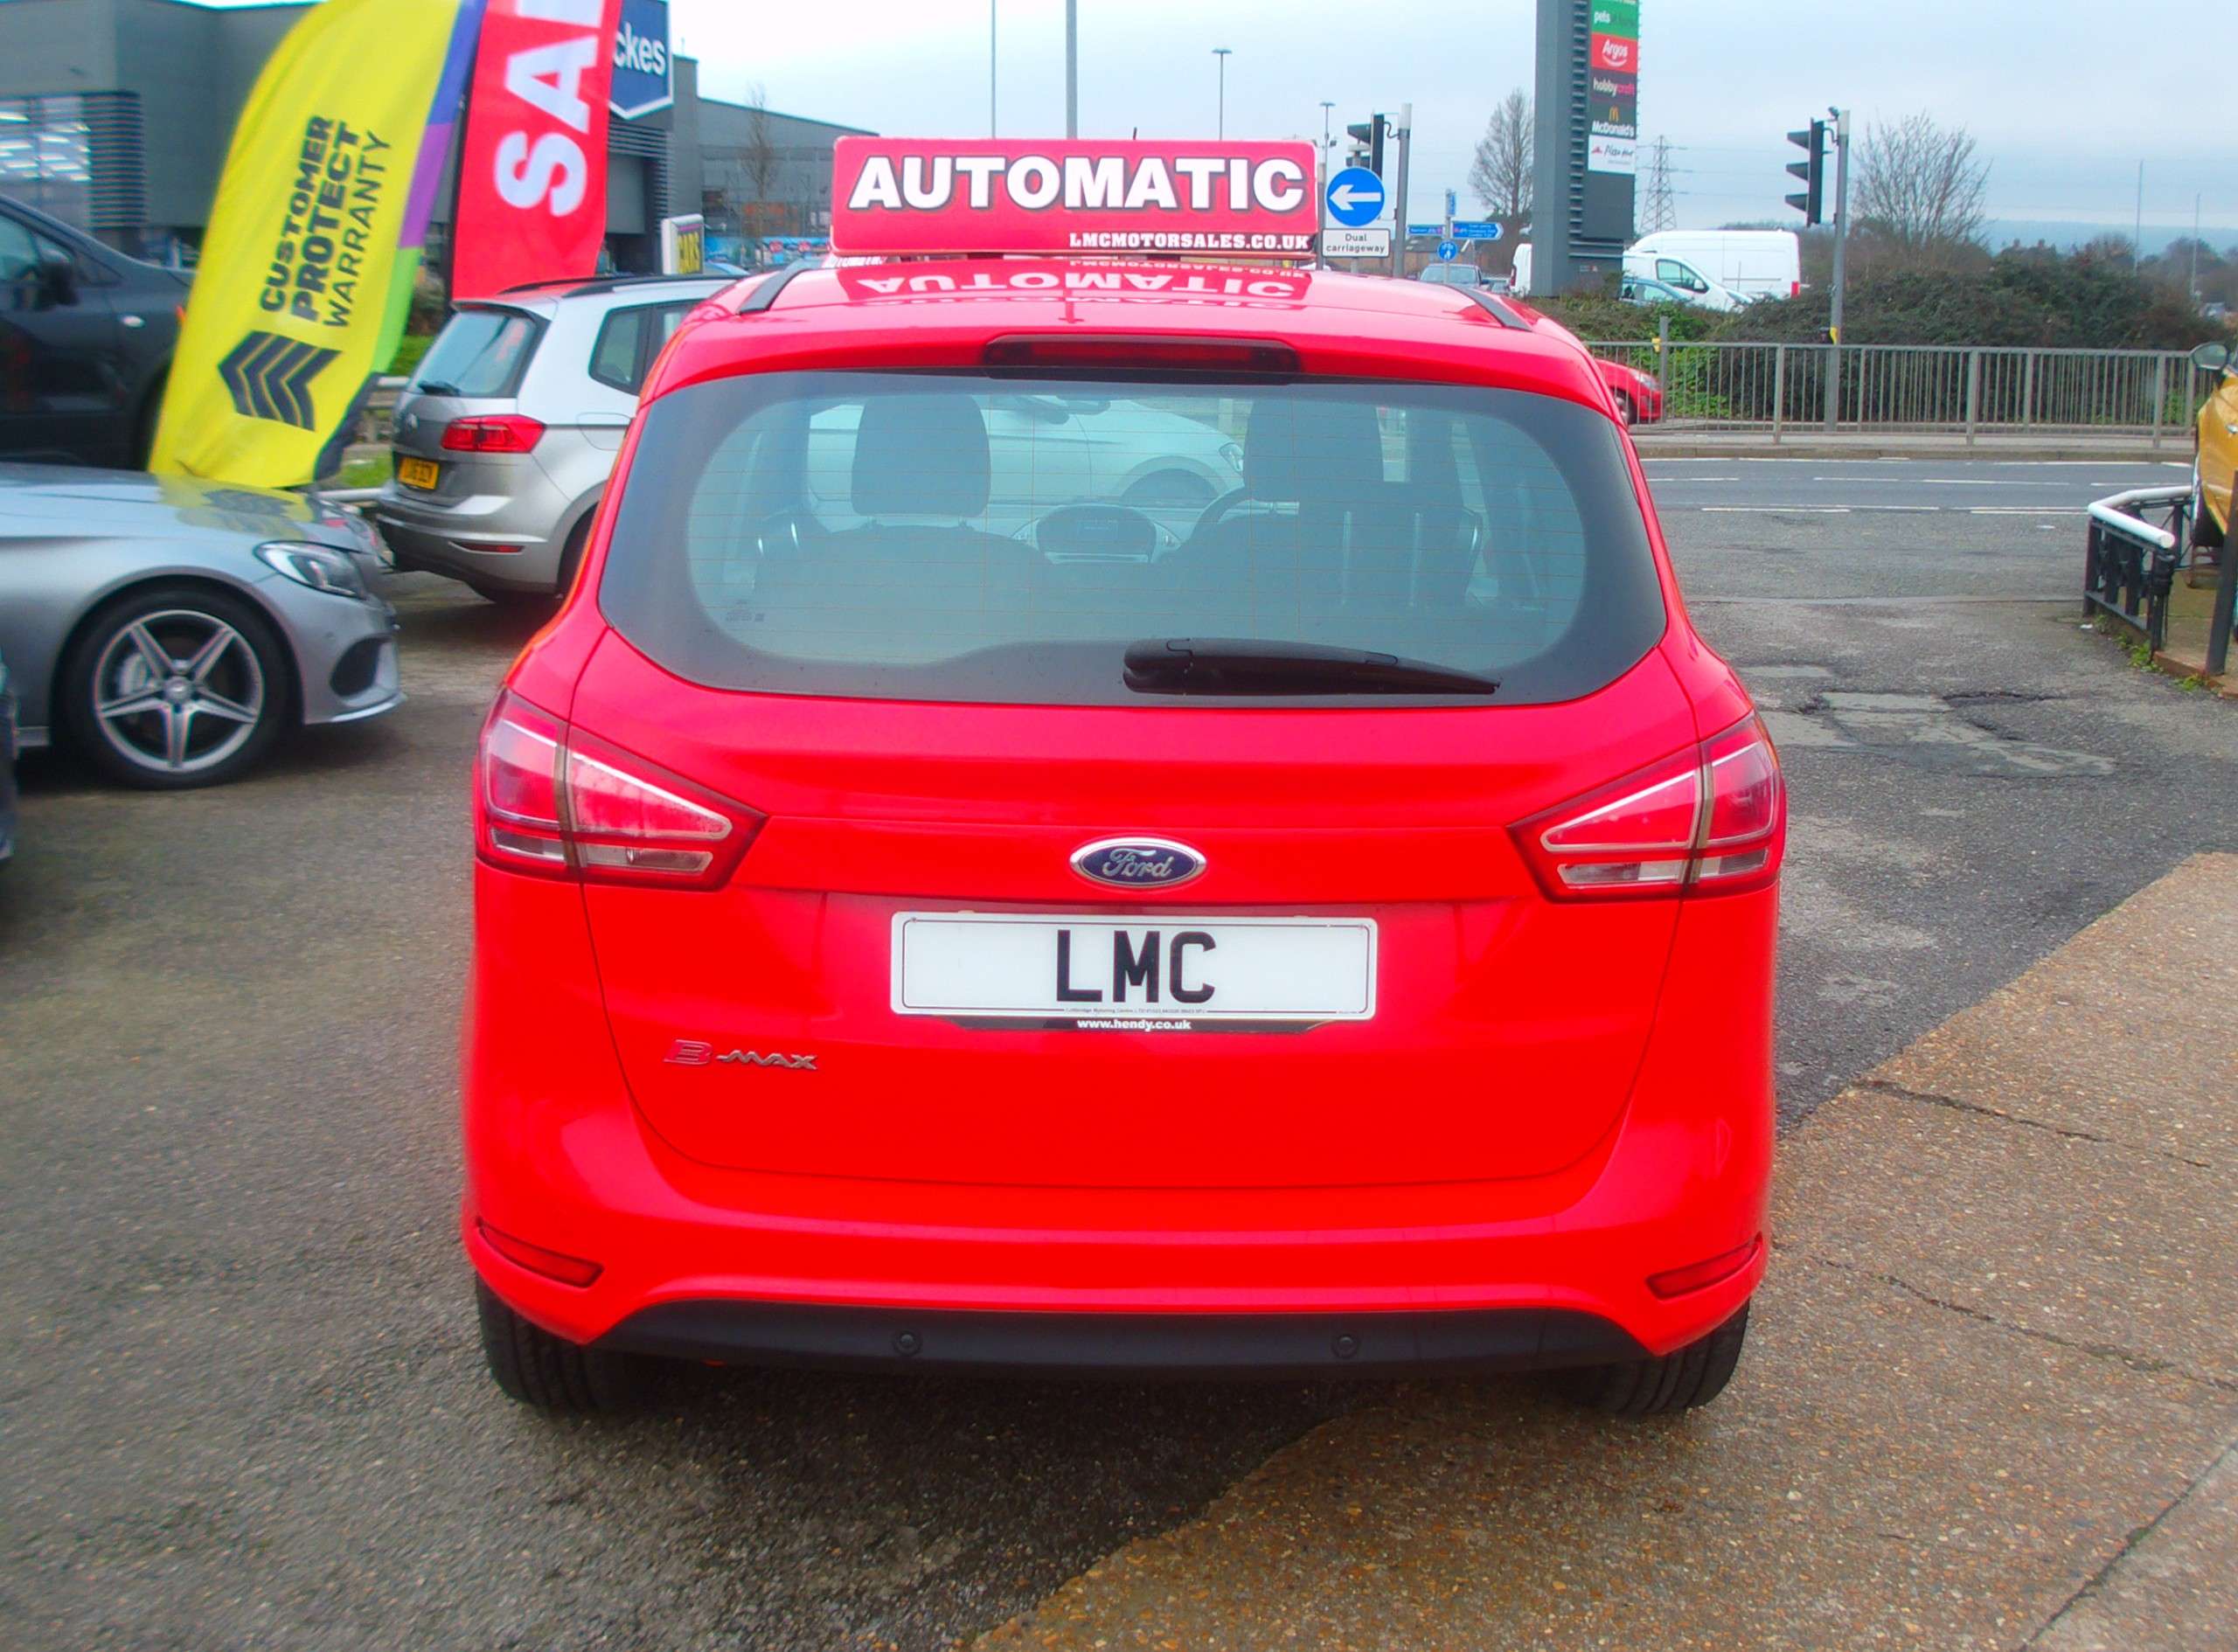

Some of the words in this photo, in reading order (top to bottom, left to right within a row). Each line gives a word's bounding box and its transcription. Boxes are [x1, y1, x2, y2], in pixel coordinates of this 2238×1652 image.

[1602, 38, 1628, 60] Argos
[1592, 120, 1635, 137] McDonald's
[848, 156, 1307, 212] AUTOMATIC
[259, 115, 334, 312] CUSTOMER
[289, 121, 360, 322] PROTECT
[323, 129, 392, 328] WARRANTY
[1069, 233, 1310, 250] LMCMOTORSALES.CO.UK
[1345, 233, 1367, 241] Dual
[1326, 244, 1385, 253] carriageway
[1102, 847, 1174, 878] Ford
[1056, 929, 1216, 1004] LMC
[1076, 1019, 1192, 1032] www.hendy.co.uk
